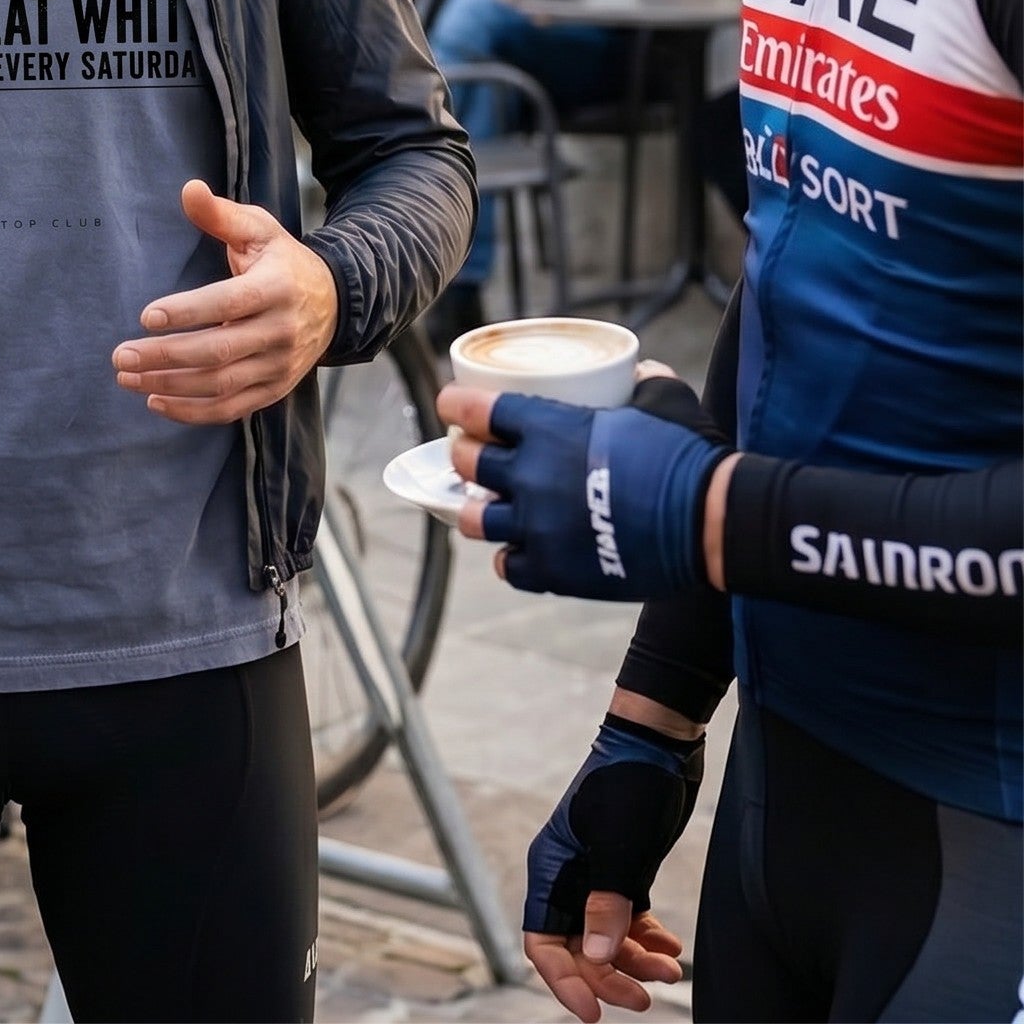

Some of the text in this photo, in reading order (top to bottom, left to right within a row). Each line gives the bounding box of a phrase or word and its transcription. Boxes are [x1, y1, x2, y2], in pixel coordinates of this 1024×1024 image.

[81, 50, 197, 80] SATURDA
[740, 19, 899, 131] Emirates
[52, 217, 104, 228] CLUB
[800, 154, 908, 240] SORT
